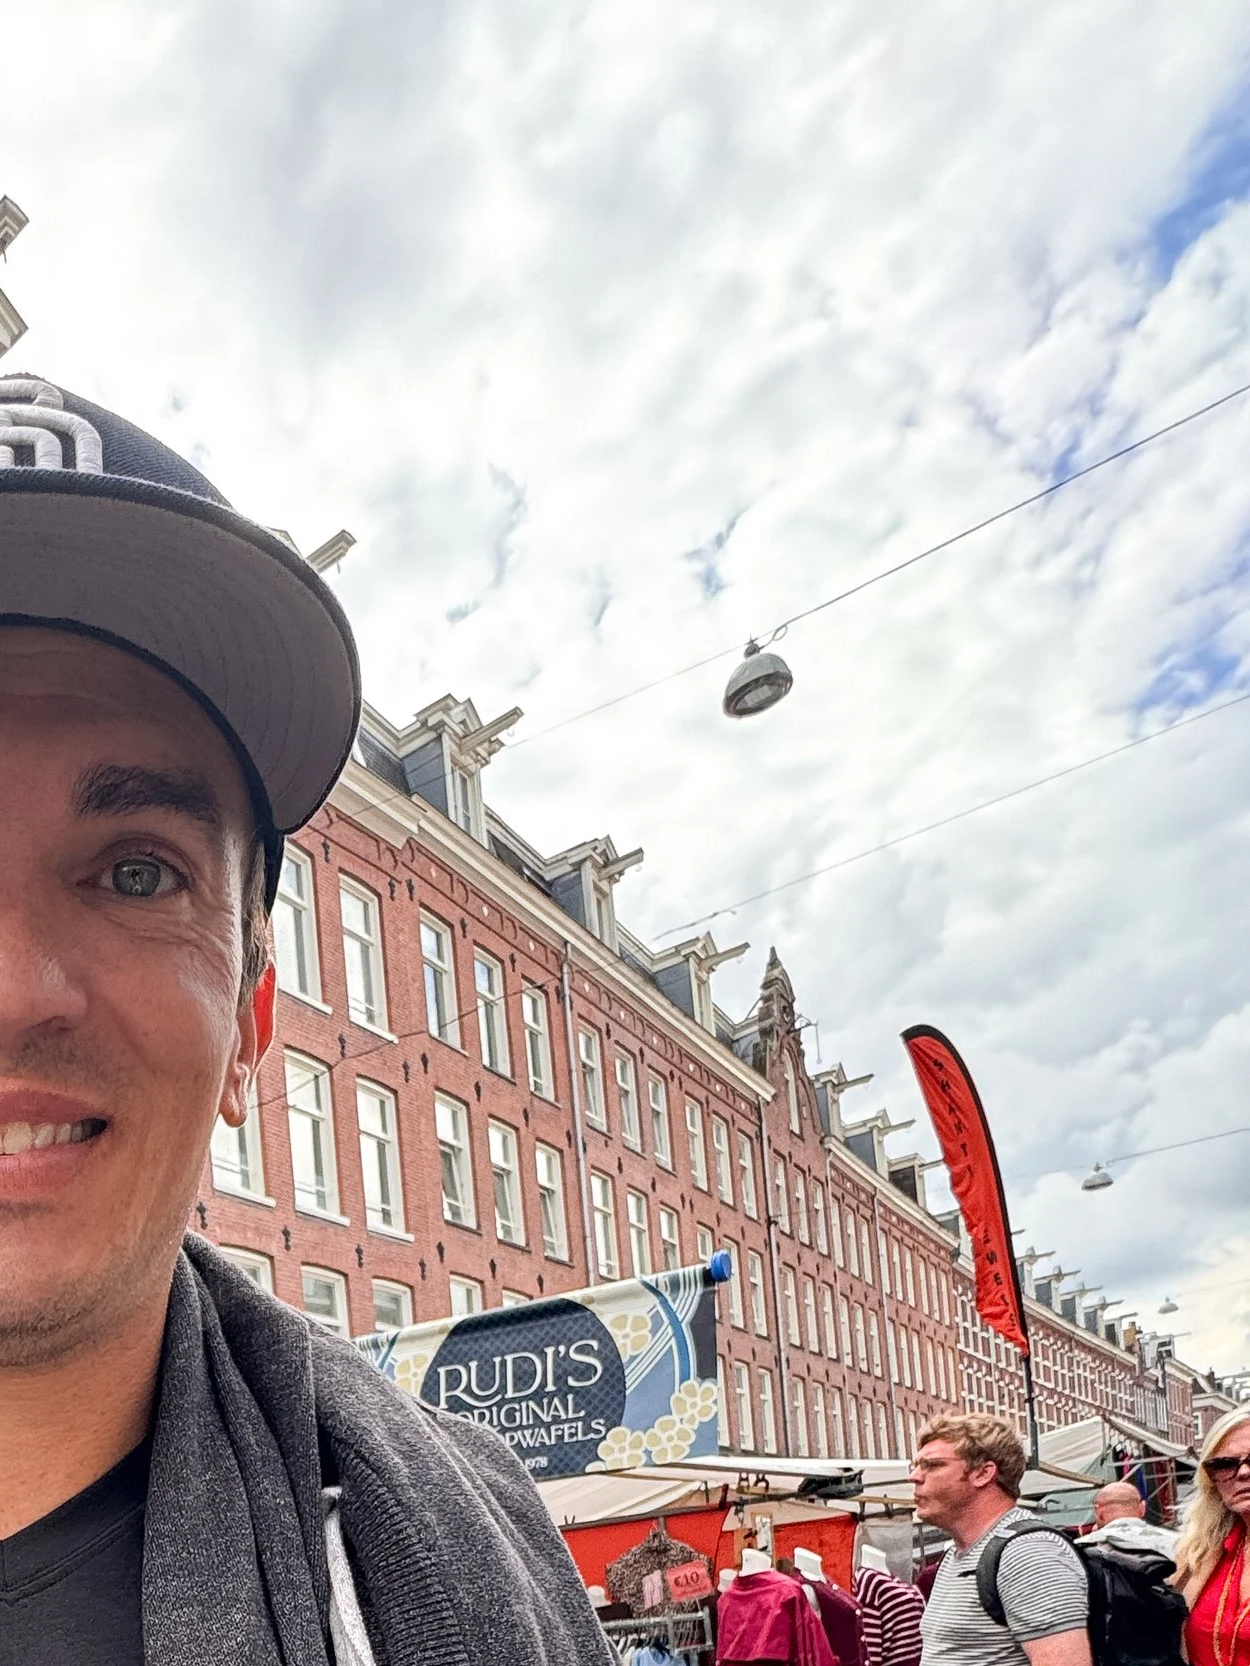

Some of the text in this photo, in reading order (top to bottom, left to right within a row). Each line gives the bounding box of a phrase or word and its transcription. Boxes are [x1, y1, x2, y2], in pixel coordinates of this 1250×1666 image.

[437, 1339, 603, 1410] RUDI'S
[504, 1418, 607, 1449] PWAFELS
[674, 1571, 700, 1588] €10
